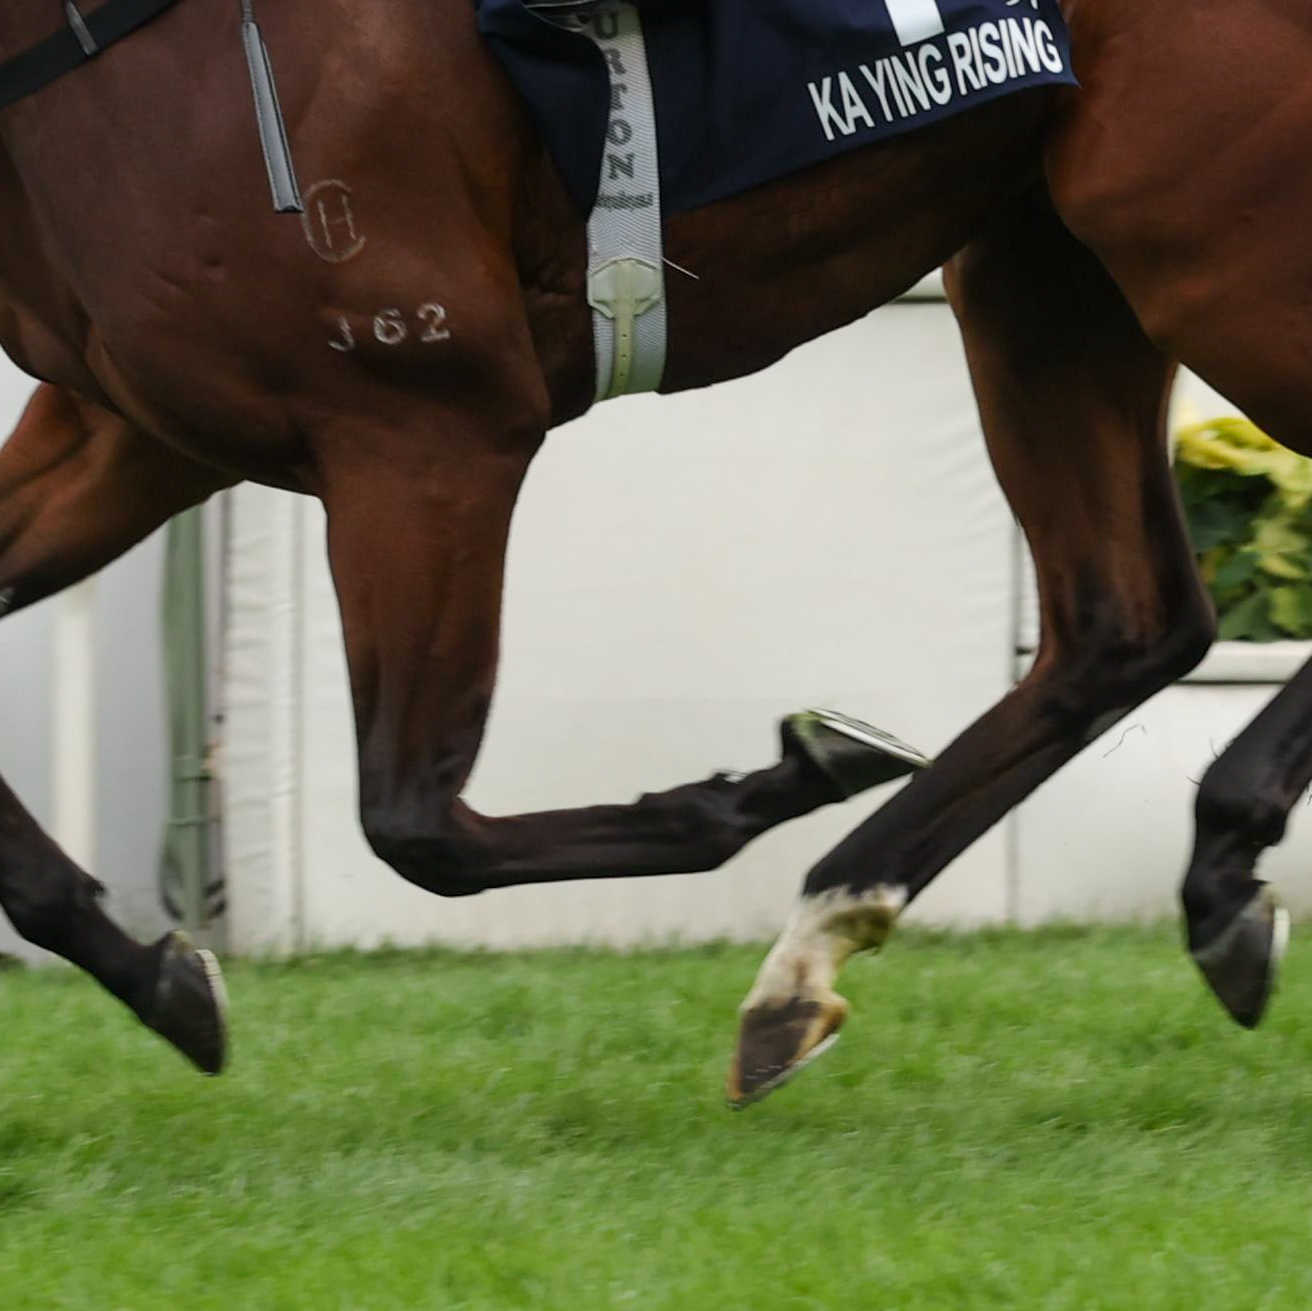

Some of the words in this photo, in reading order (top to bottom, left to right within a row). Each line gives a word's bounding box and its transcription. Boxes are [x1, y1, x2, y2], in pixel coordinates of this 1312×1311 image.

[807, 68, 875, 141] KA
[858, 43, 952, 122] YING
[946, 17, 1063, 96] RISING
